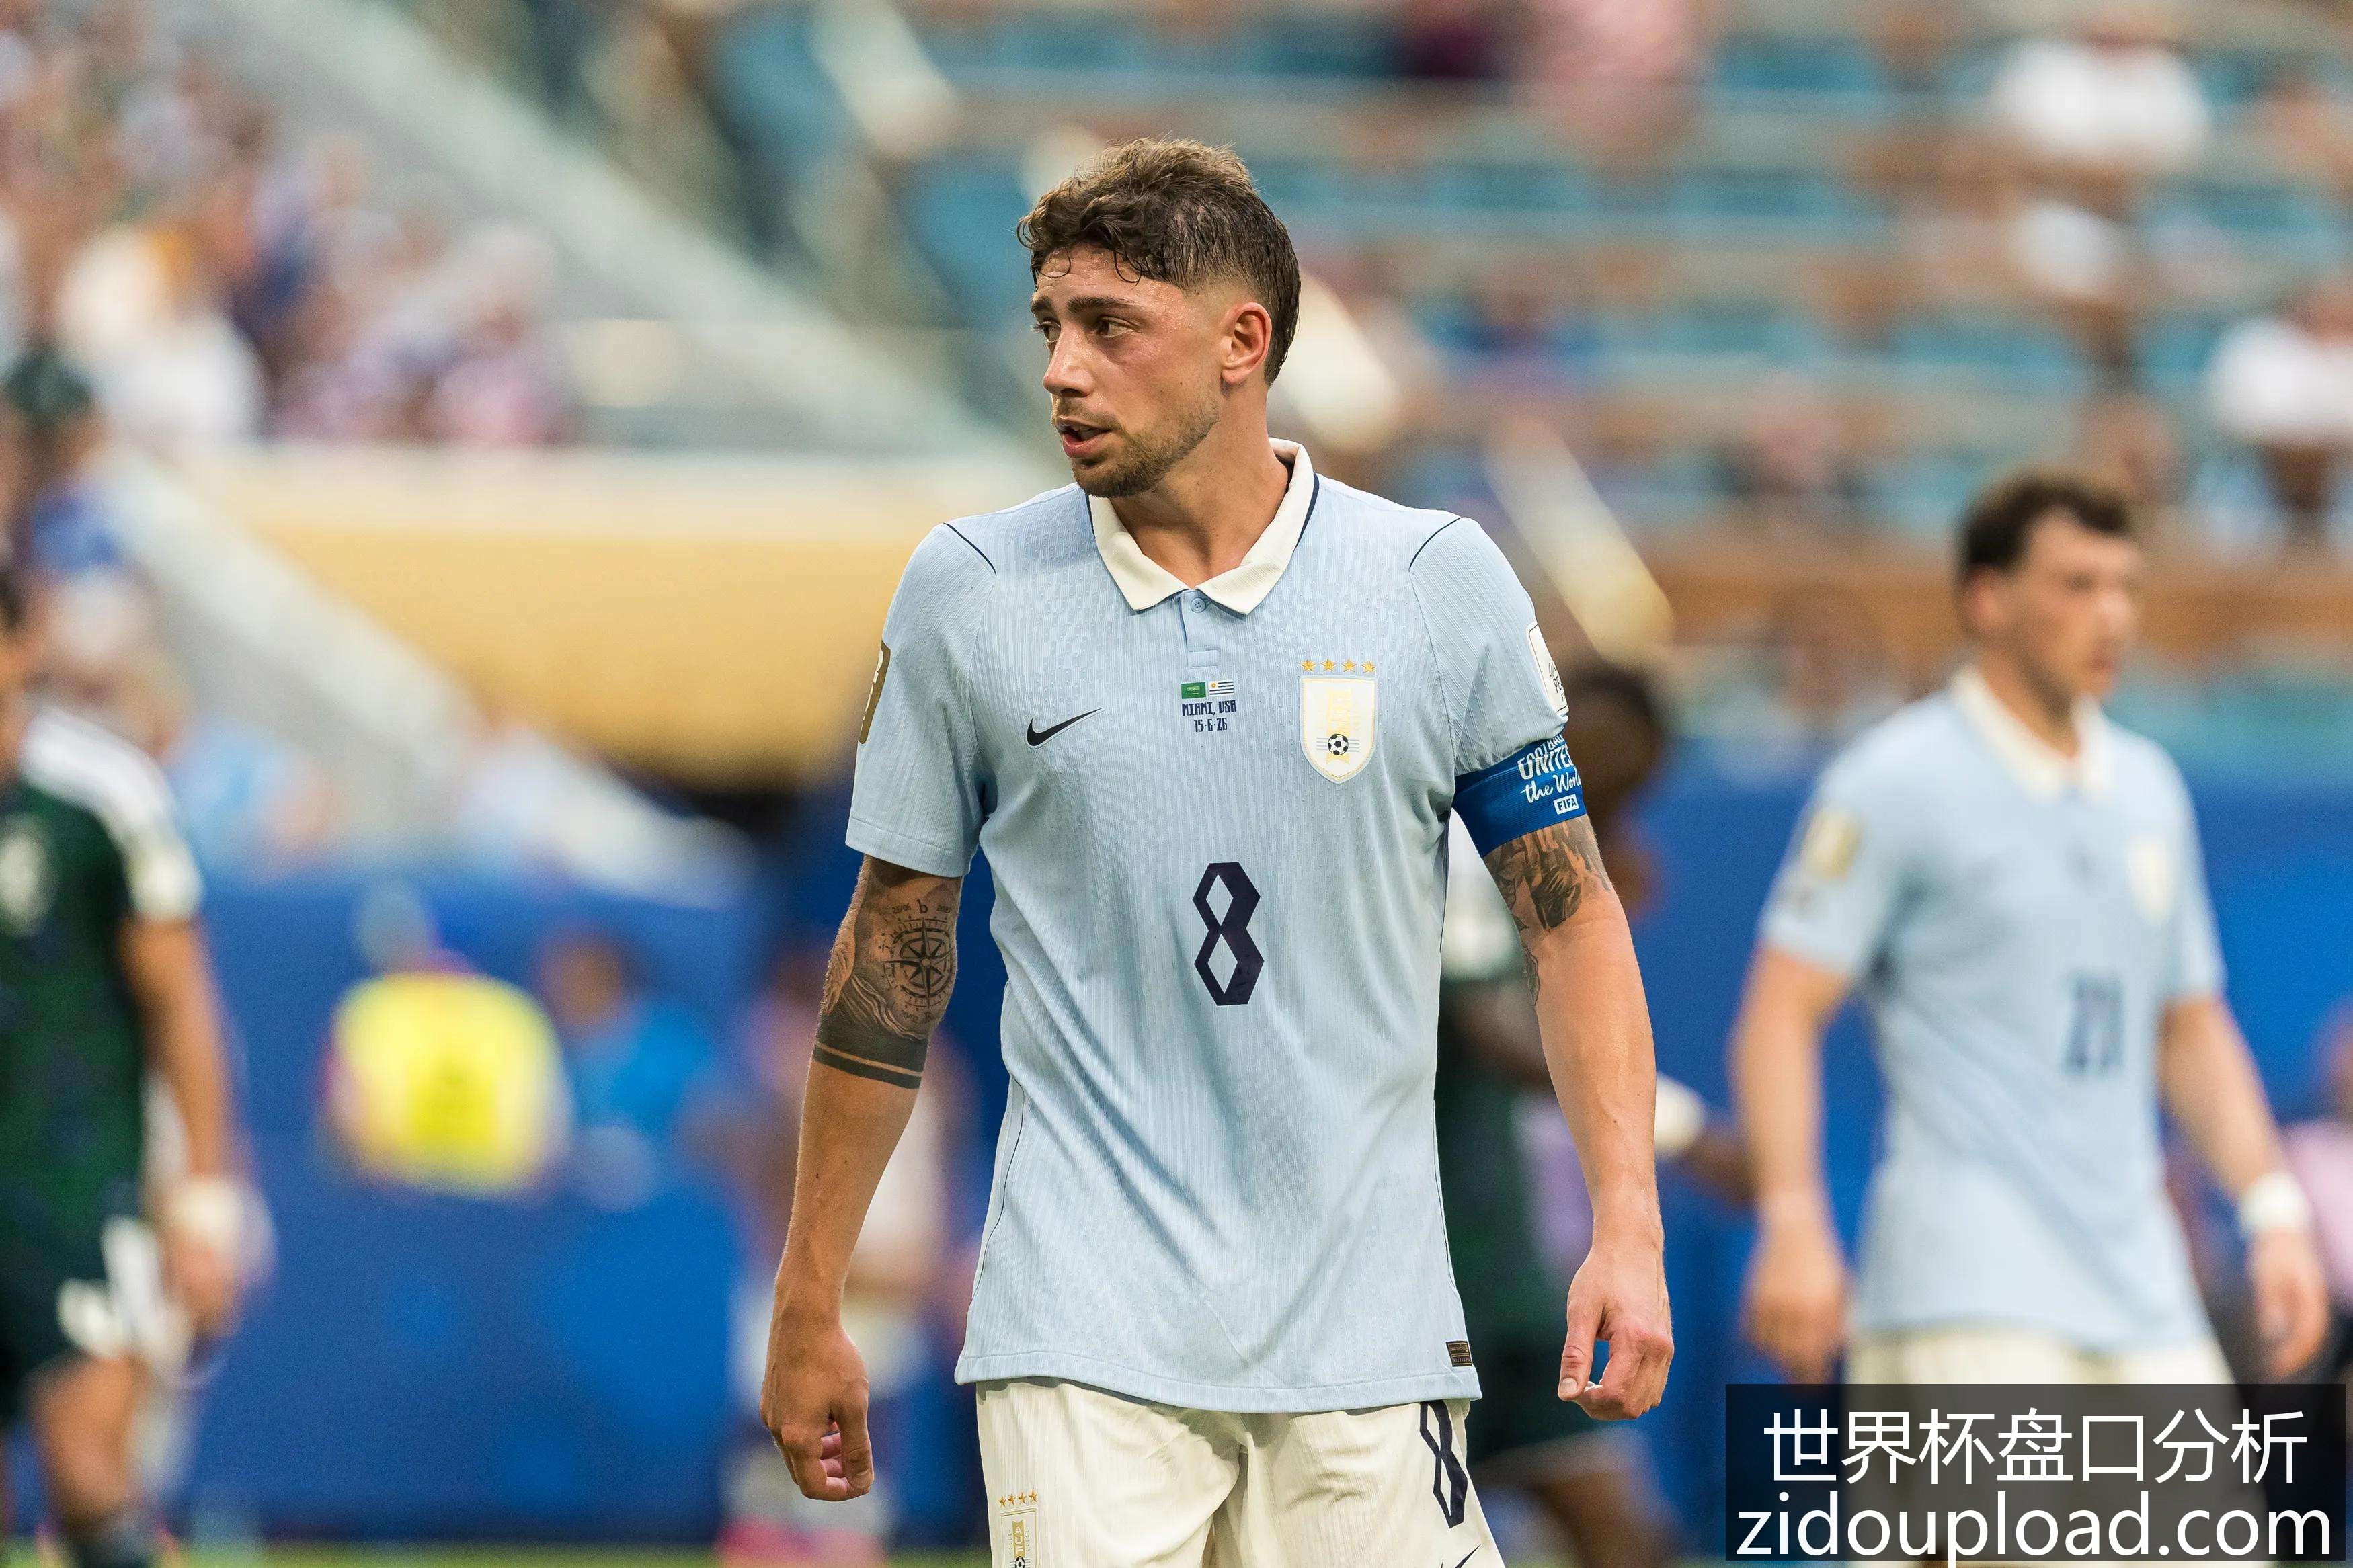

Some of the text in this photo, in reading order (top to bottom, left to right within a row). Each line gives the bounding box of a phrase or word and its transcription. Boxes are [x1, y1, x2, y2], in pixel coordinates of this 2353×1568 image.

[1181, 700, 1236, 716] MIAMI, USA
[1520, 780, 1554, 803] the
[1557, 797, 1577, 811] FIFA
[1192, 862, 1265, 1006] 8
[1420, 1401, 1468, 1529] 8
